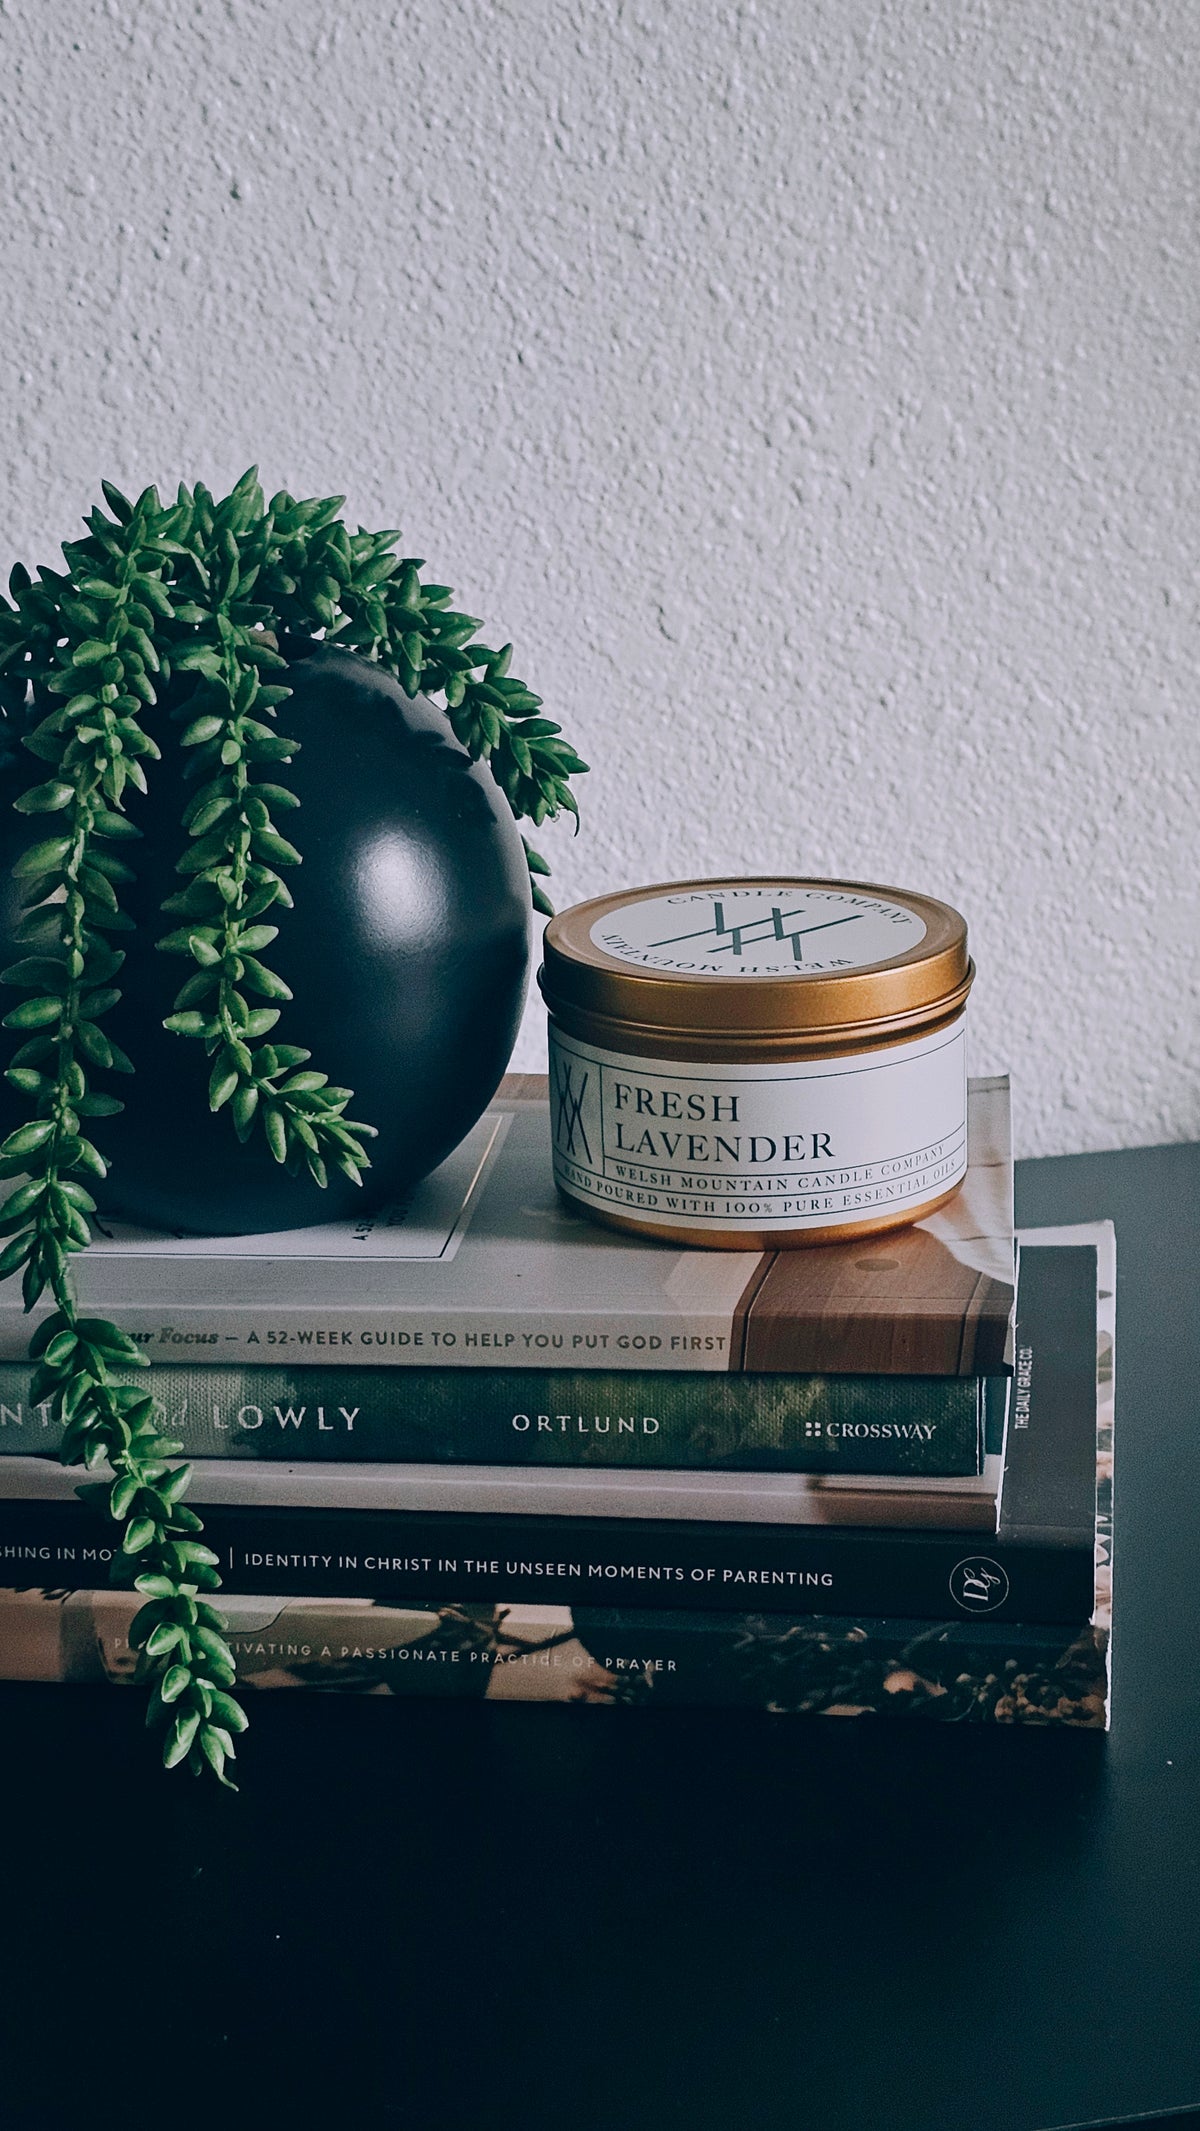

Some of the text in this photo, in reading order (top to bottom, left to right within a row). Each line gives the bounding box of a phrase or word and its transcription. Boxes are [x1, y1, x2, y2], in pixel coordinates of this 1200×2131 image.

[667, 889, 913, 926] CANDLE COMPANY
[601, 932, 854, 973] WELSH MOUNTAIN
[614, 1082, 741, 1122] FRESH
[616, 1123, 836, 1166] LAVENDER
[616, 1144, 945, 1192] WELSH MOUNTAIN CANDLE COMPANY
[596, 1180, 658, 1205] POURED
[666, 1198, 715, 1213] WITH
[783, 1198, 833, 1213] PURE
[843, 1176, 929, 1206] ESSENTIAL
[933, 1159, 957, 1179] OILS
[158, 1327, 219, 1345] Focus
[247, 1331, 260, 1344] A
[267, 1330, 353, 1345] 52-WEEK
[360, 1331, 424, 1346] GUIDE
[431, 1332, 457, 1347] TO
[465, 1333, 515, 1348] HELP
[521, 1334, 564, 1348] YOU
[572, 1335, 609, 1349] PUT
[617, 1335, 662, 1350] GOD
[671, 1336, 726, 1351] FIRST
[1017, 1360, 1032, 1388] GRACE
[1015, 1388, 1031, 1412] DAILY
[213, 1404, 361, 1431] LOWLY
[512, 1414, 660, 1434] ORTLUND
[826, 1422, 937, 1440] CROSSWAY
[1014, 1413, 1030, 1430] THE
[57, 1547, 76, 1561] IN
[245, 1553, 833, 1586] IDENTITY IN CHRIST IN THE UNSEEN MOMENTS OF PARENTING
[321, 1646, 332, 1657] A
[341, 1646, 460, 1662] PASSIONATE
[470, 1652, 563, 1666] PRACTICE
[573, 1656, 596, 1669] OF
[605, 1658, 677, 1671] PRAYER
